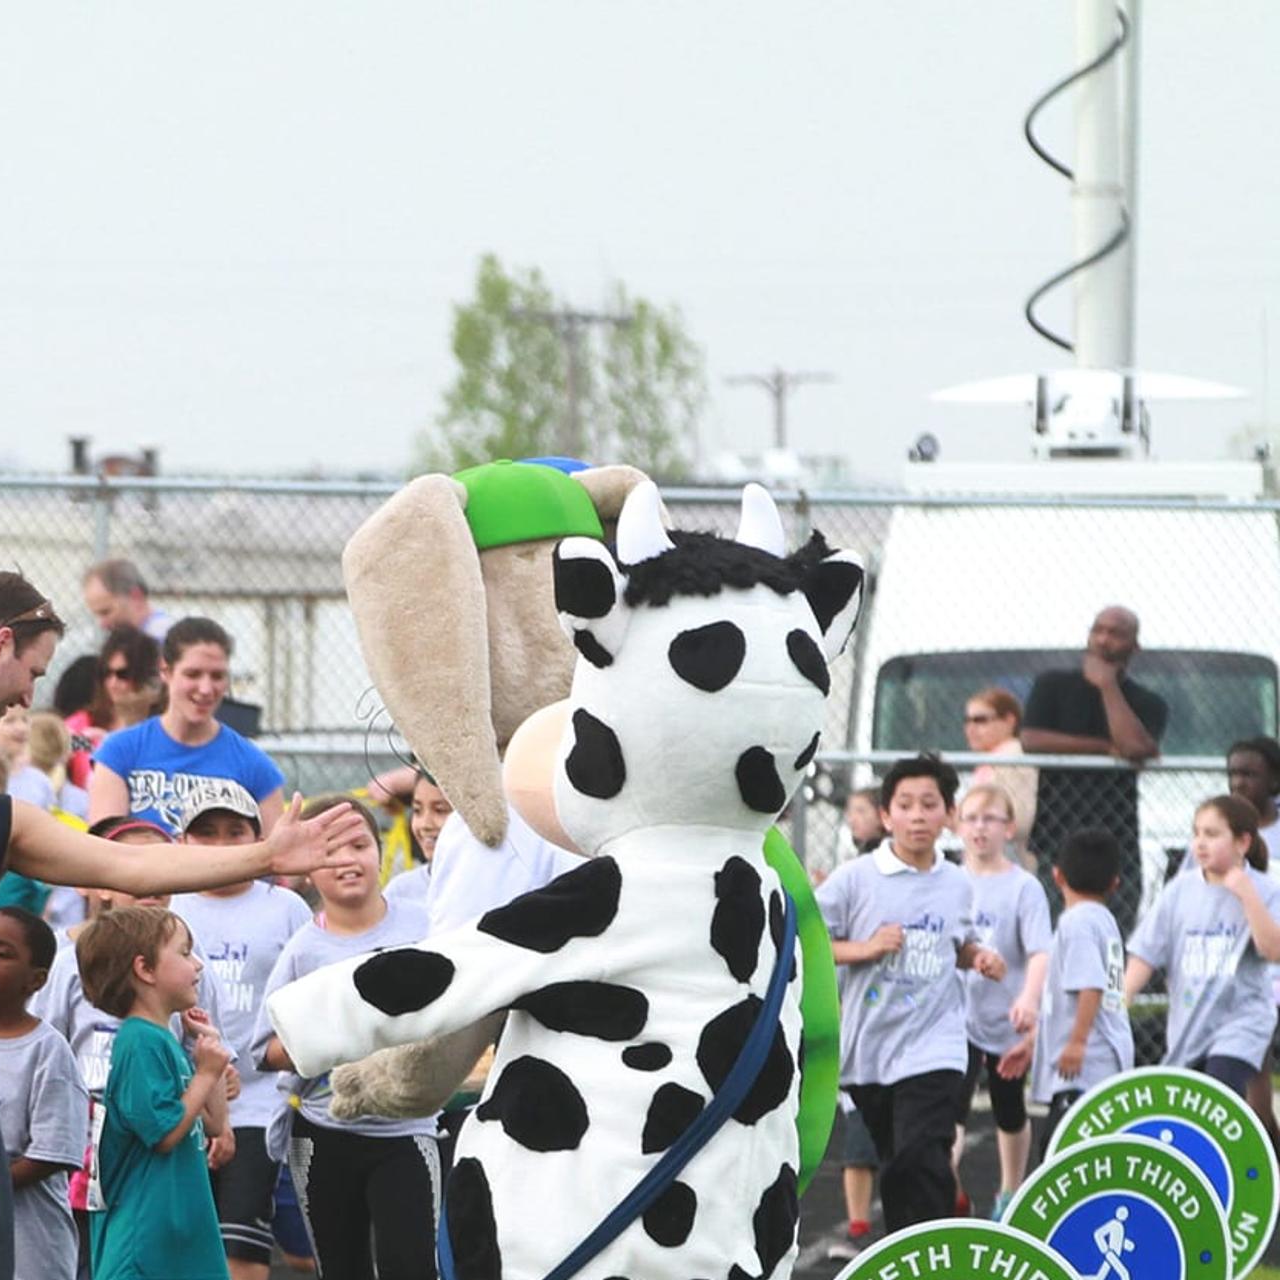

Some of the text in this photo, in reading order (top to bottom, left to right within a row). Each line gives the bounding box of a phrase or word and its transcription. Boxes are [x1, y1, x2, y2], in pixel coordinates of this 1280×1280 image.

[1077, 1085, 1244, 1142] FIFTH THIRD
[1031, 1156, 1200, 1220] FIFTH THIRD
[1231, 1212, 1260, 1263] UN
